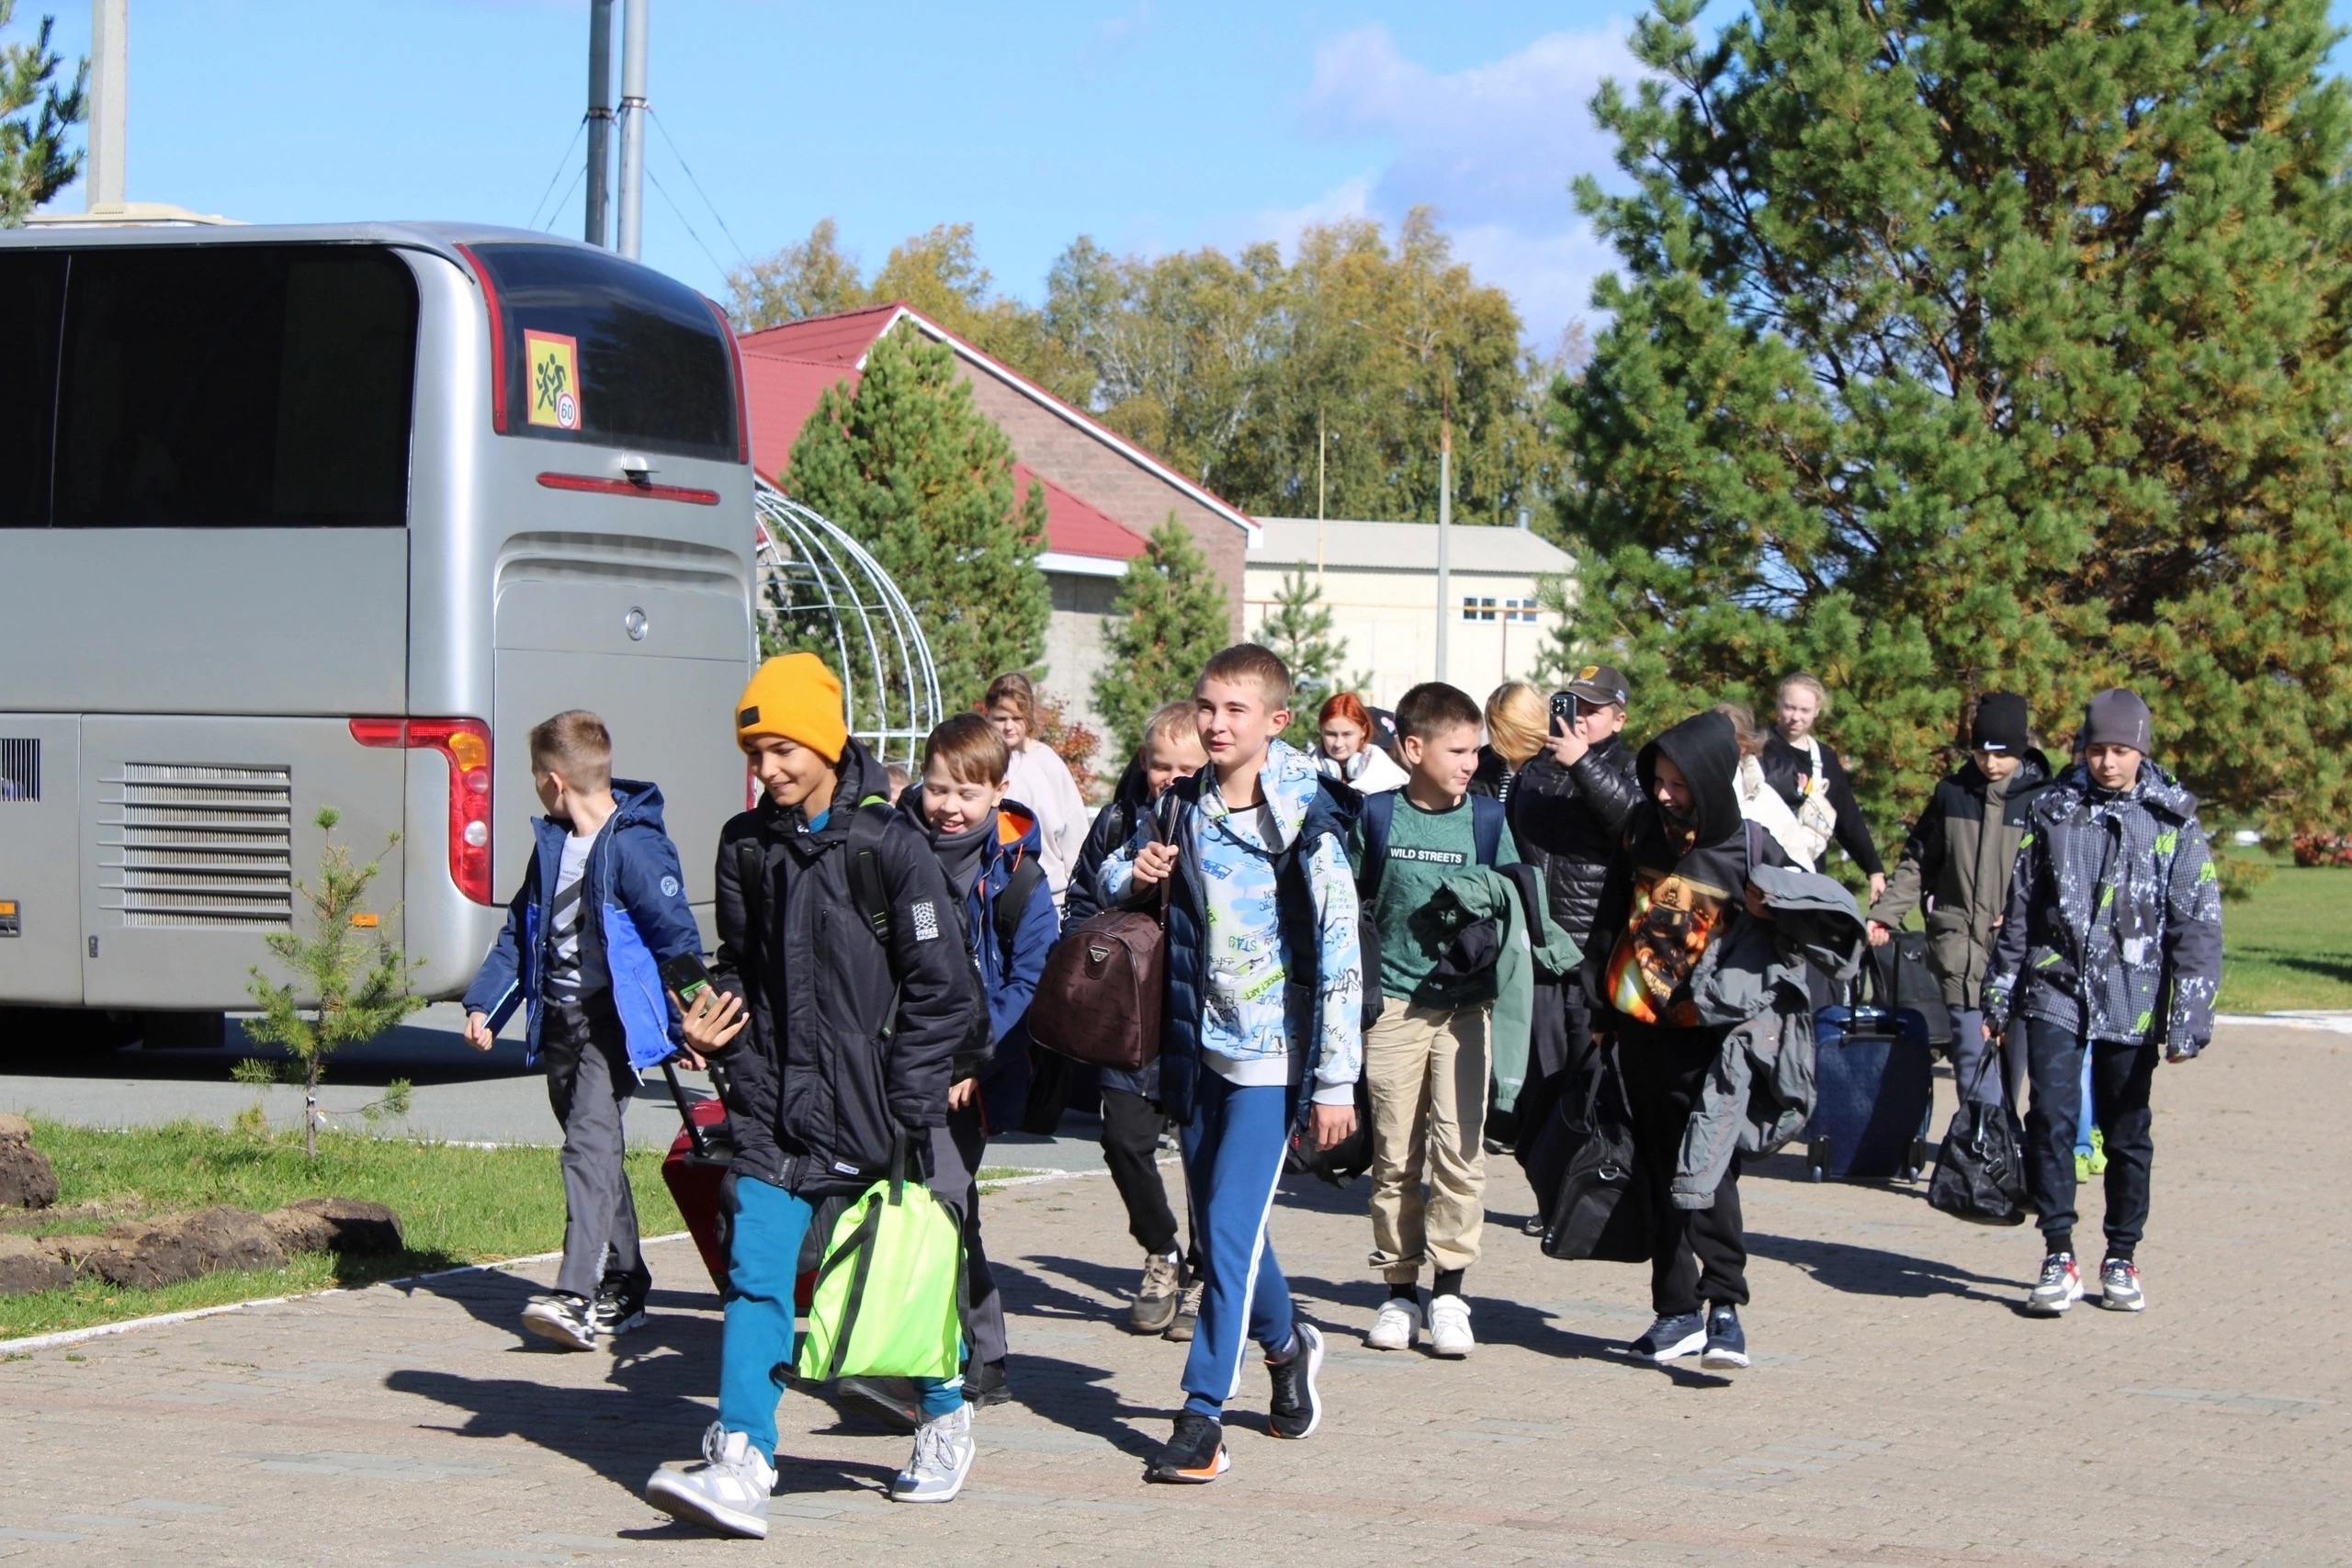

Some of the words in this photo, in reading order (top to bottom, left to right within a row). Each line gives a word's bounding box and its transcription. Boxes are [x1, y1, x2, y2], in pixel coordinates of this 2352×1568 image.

[561, 403, 573, 420] 60
[1390, 848, 1417, 859] WILD
[1418, 850, 1463, 863] STREETS
